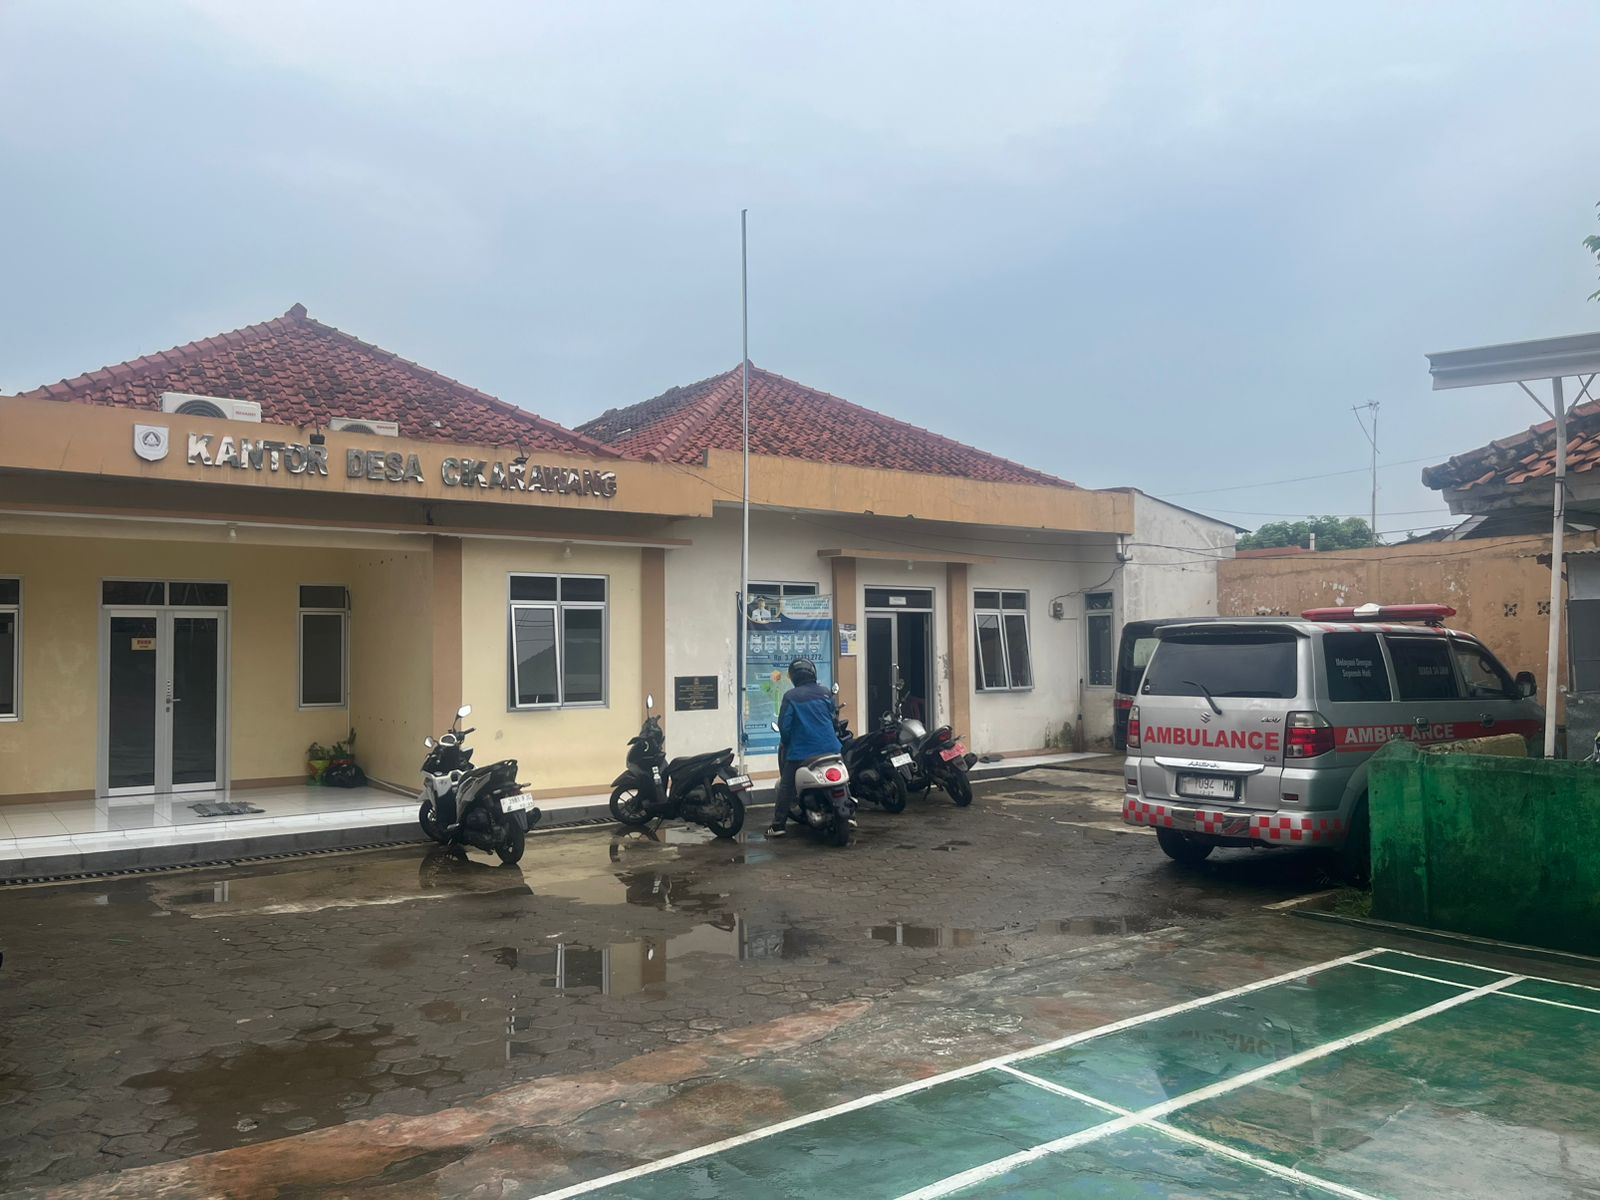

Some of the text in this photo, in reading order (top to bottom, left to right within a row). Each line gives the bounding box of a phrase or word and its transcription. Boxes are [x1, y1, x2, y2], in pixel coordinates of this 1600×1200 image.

[187, 431, 617, 498] KANTOR DESA CIKARAWANG
[1143, 726, 1280, 751] AMBULANCE
